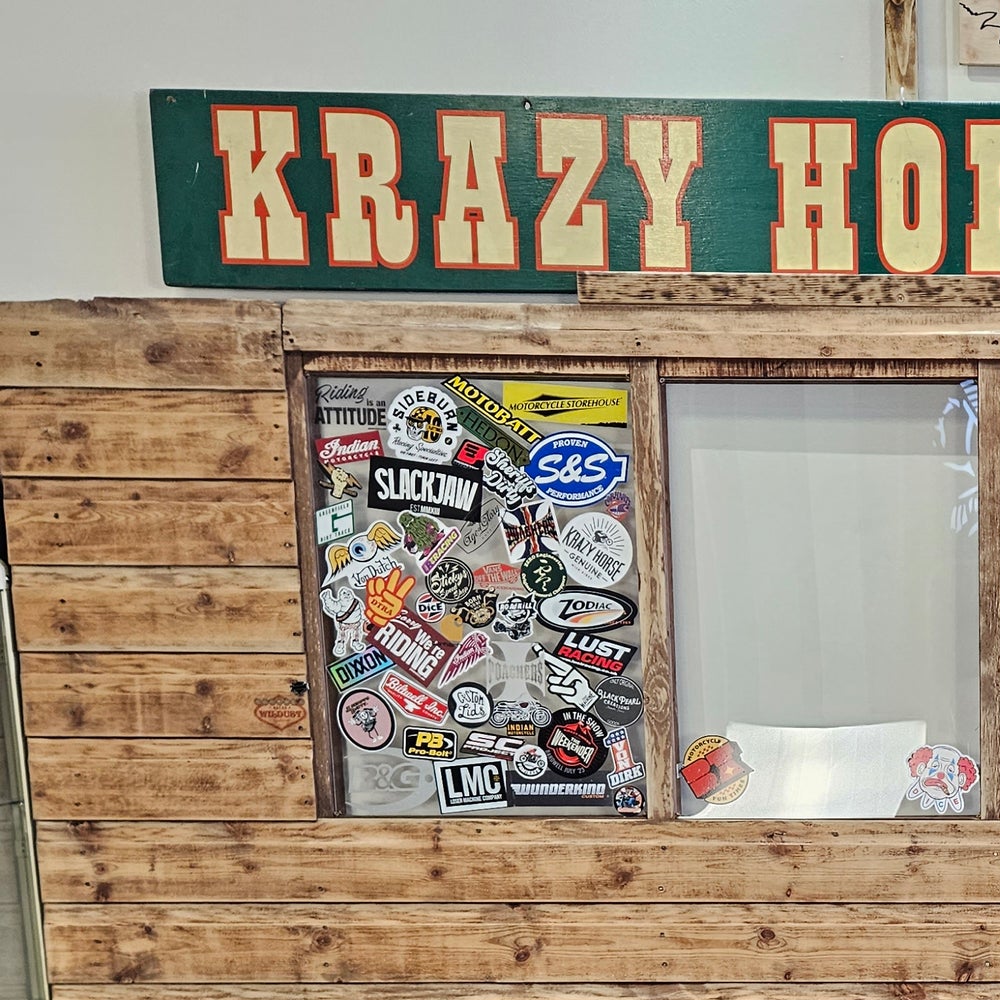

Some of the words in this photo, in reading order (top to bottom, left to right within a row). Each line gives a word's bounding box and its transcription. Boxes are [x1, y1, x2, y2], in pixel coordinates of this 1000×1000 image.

[211, 104, 702, 271] KRAZY
[316, 384, 369, 404] Riding
[509, 400, 566, 411] MOTORCYCLE
[566, 398, 620, 409] STOREHOUSE
[315, 406, 387, 426] ATTITUDE
[392, 390, 459, 432] SIDEBURN
[449, 375, 543, 445] MOTOBATT
[319, 439, 380, 459] Indian
[463, 411, 523, 463] HEDON
[552, 439, 588, 449] PROVEN
[486, 449, 537, 495] Sheriffs
[535, 453, 609, 484] S&S
[375, 467, 479, 512] SLACKJAW
[483, 472, 522, 504] Dirty
[545, 485, 604, 501] PERFORMANCE
[562, 526, 593, 557] KRAZY
[593, 549, 625, 581] HORSE
[569, 552, 602, 579] GENUINE
[368, 556, 398, 580] Dutch
[464, 595, 482, 607] BORN
[558, 599, 613, 621] ZODIAC
[373, 622, 439, 679] RIDING
[414, 629, 446, 660] We're
[564, 631, 631, 660] LUST
[335, 649, 388, 684] DIXXON
[558, 646, 624, 672] RACING
[456, 690, 485, 705] CUSTOM
[619, 695, 641, 706] PEARL
[563, 712, 572, 721] IN
[573, 711, 585, 722] THE
[586, 718, 605, 738] SHOW
[408, 747, 450, 758] Pro-Bolt
[415, 731, 444, 749] PB
[466, 732, 525, 750] SC
[551, 728, 595, 764] WEEKENDER
[614, 741, 632, 771] VON
[361, 761, 422, 791] R&G
[445, 764, 501, 799] LMC
[510, 782, 606, 797] WUNDERKIND
[610, 766, 643, 786] DIRK
